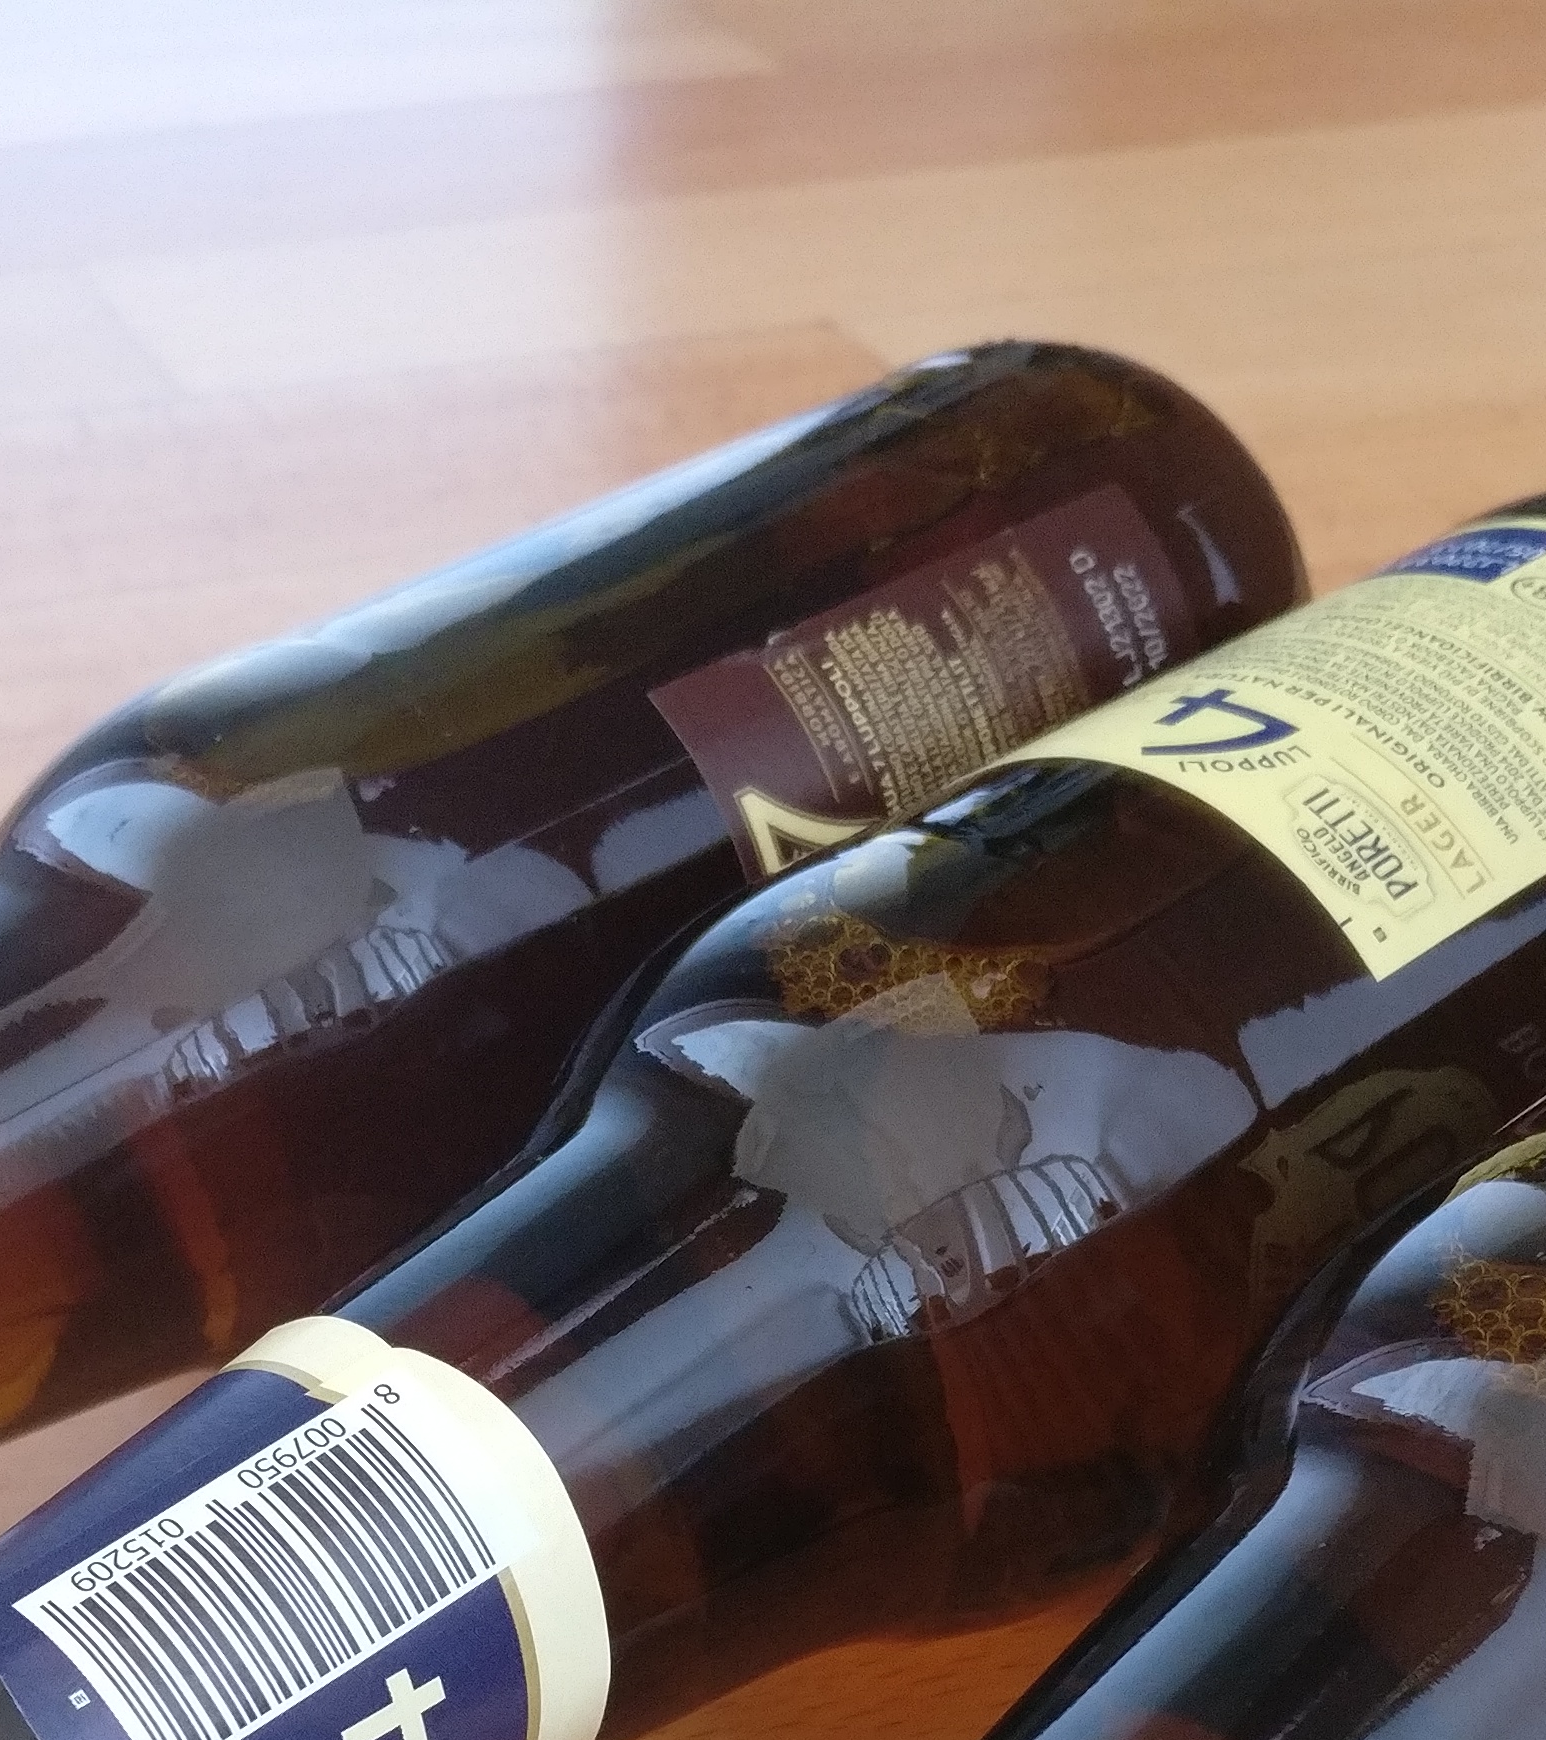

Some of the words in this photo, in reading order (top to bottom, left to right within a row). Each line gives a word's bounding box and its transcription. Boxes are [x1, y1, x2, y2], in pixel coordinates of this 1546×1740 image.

[783, 652, 855, 766] AROMATICA
[819, 658, 882, 756] LUPPOLI
[1141, 688, 1300, 757] 4
[1284, 684, 1331, 706] PER
[1180, 741, 1311, 772] LUPPOLI
[1331, 701, 1445, 788] ORIGINALI
[1469, 711, 1510, 747] GUSTO
[1506, 743, 1530, 768] DAL
[1433, 732, 1510, 810] PERFEZIONATA
[1471, 748, 1499, 776] UNA
[1497, 754, 1525, 784] 2014
[1464, 780, 1499, 819] BIRRA
[1494, 772, 1544, 829] LUPPOLO
[1521, 781, 1544, 807] DAL
[1301, 787, 1419, 902] PORETTI
[1312, 825, 1371, 883] ANGELO
[1397, 791, 1487, 896] LAGER
[1494, 815, 1520, 845] UNA
[1295, 826, 1360, 895] BIRRIFICIO
[373, 1383, 401, 1405] 8
[237, 1416, 347, 1489] 007950
[70, 1517, 185, 1593] 015209
